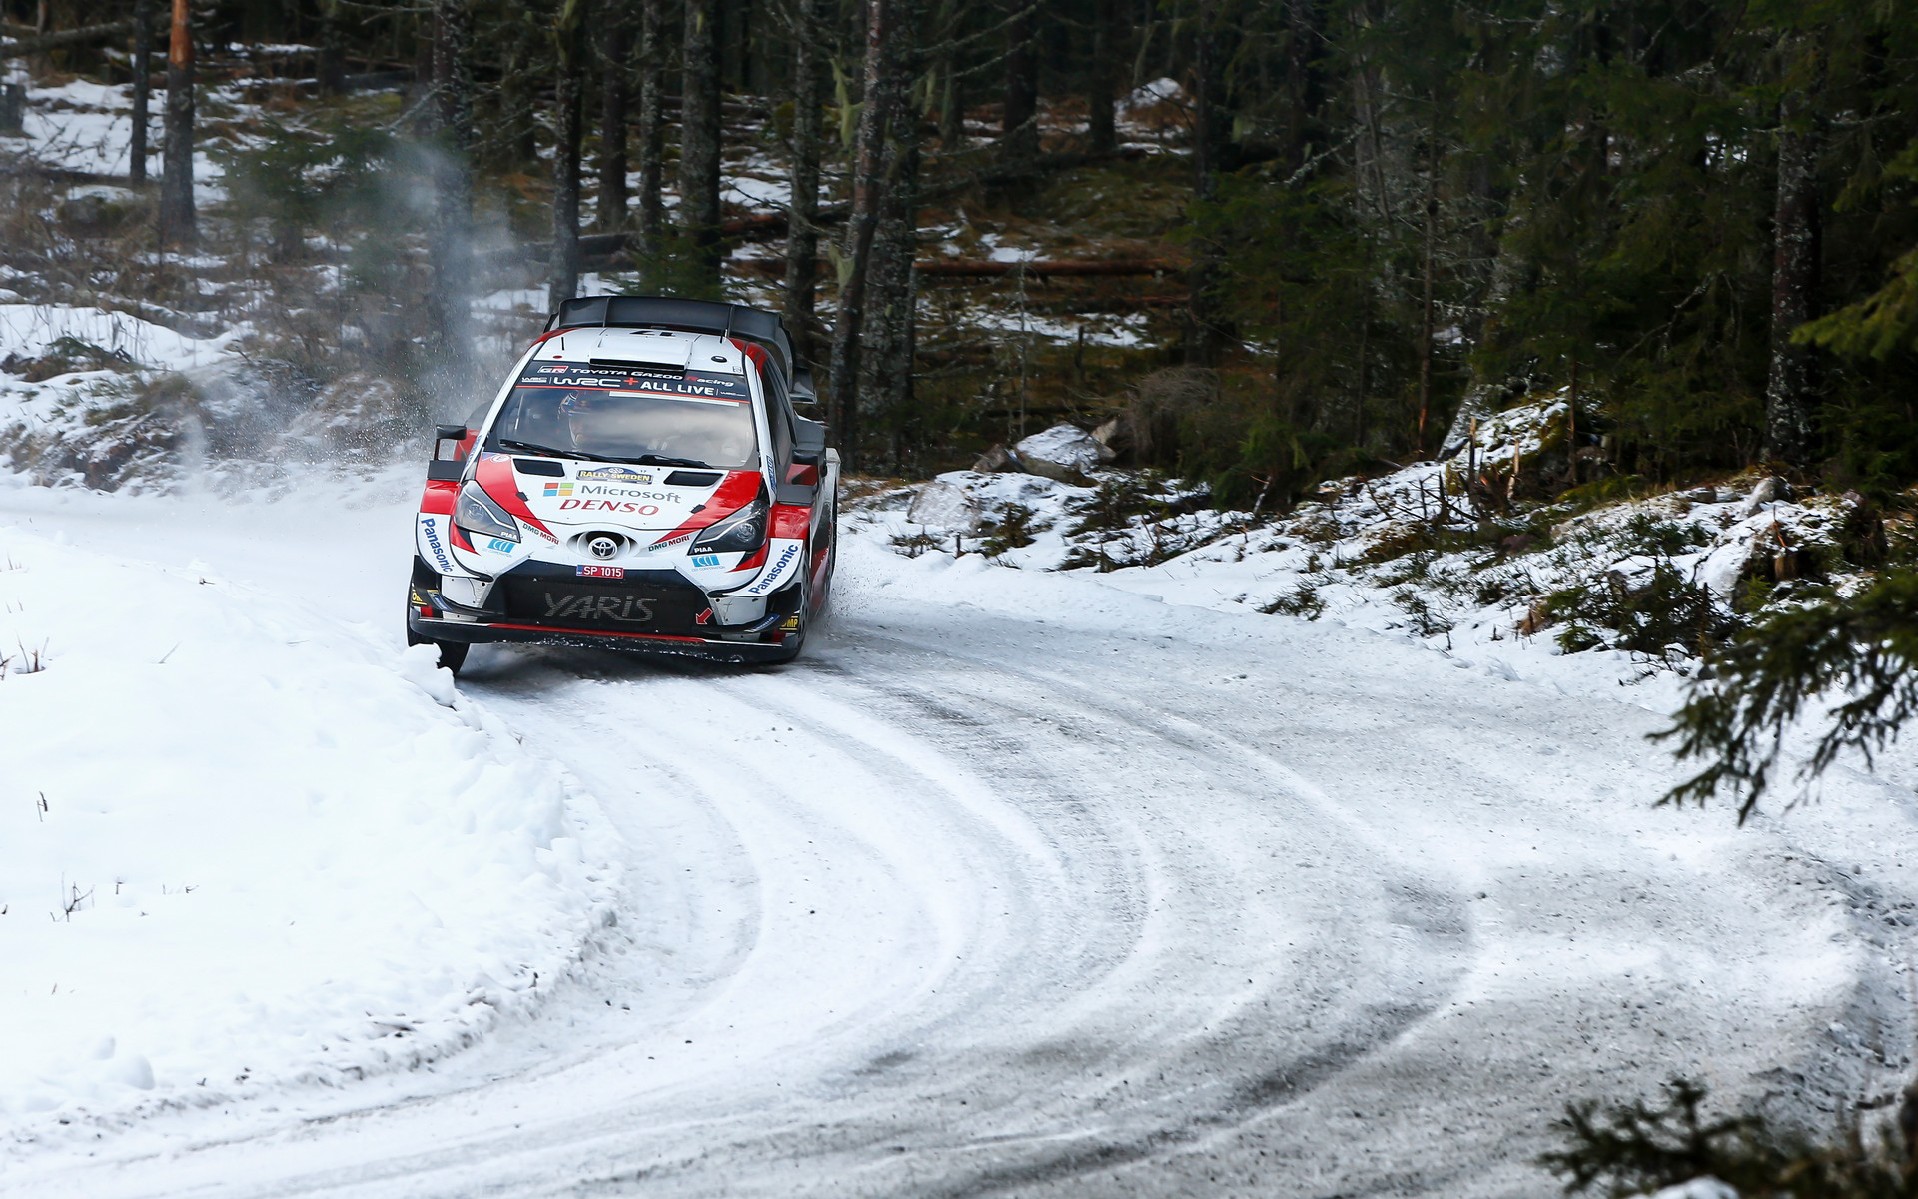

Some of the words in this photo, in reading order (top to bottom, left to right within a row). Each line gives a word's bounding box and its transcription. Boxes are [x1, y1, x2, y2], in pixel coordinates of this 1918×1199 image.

[630, 371, 683, 380] GAZOO
[687, 376, 734, 387] Racing
[640, 381, 672, 391] ALL
[677, 384, 715, 396] LIVE
[611, 473, 650, 481] SWEDEN
[581, 485, 682, 504] Microsoft
[559, 499, 659, 516] DENSO
[500, 531, 518, 539] PIAA
[522, 523, 539, 536] DMG
[539, 533, 560, 545] MORI
[421, 518, 455, 573] Panasonic
[648, 542, 668, 552] DMG
[668, 535, 690, 546] MORI
[583, 566, 598, 576] SP
[601, 567, 622, 577] 1015
[748, 544, 799, 594] Panasonic
